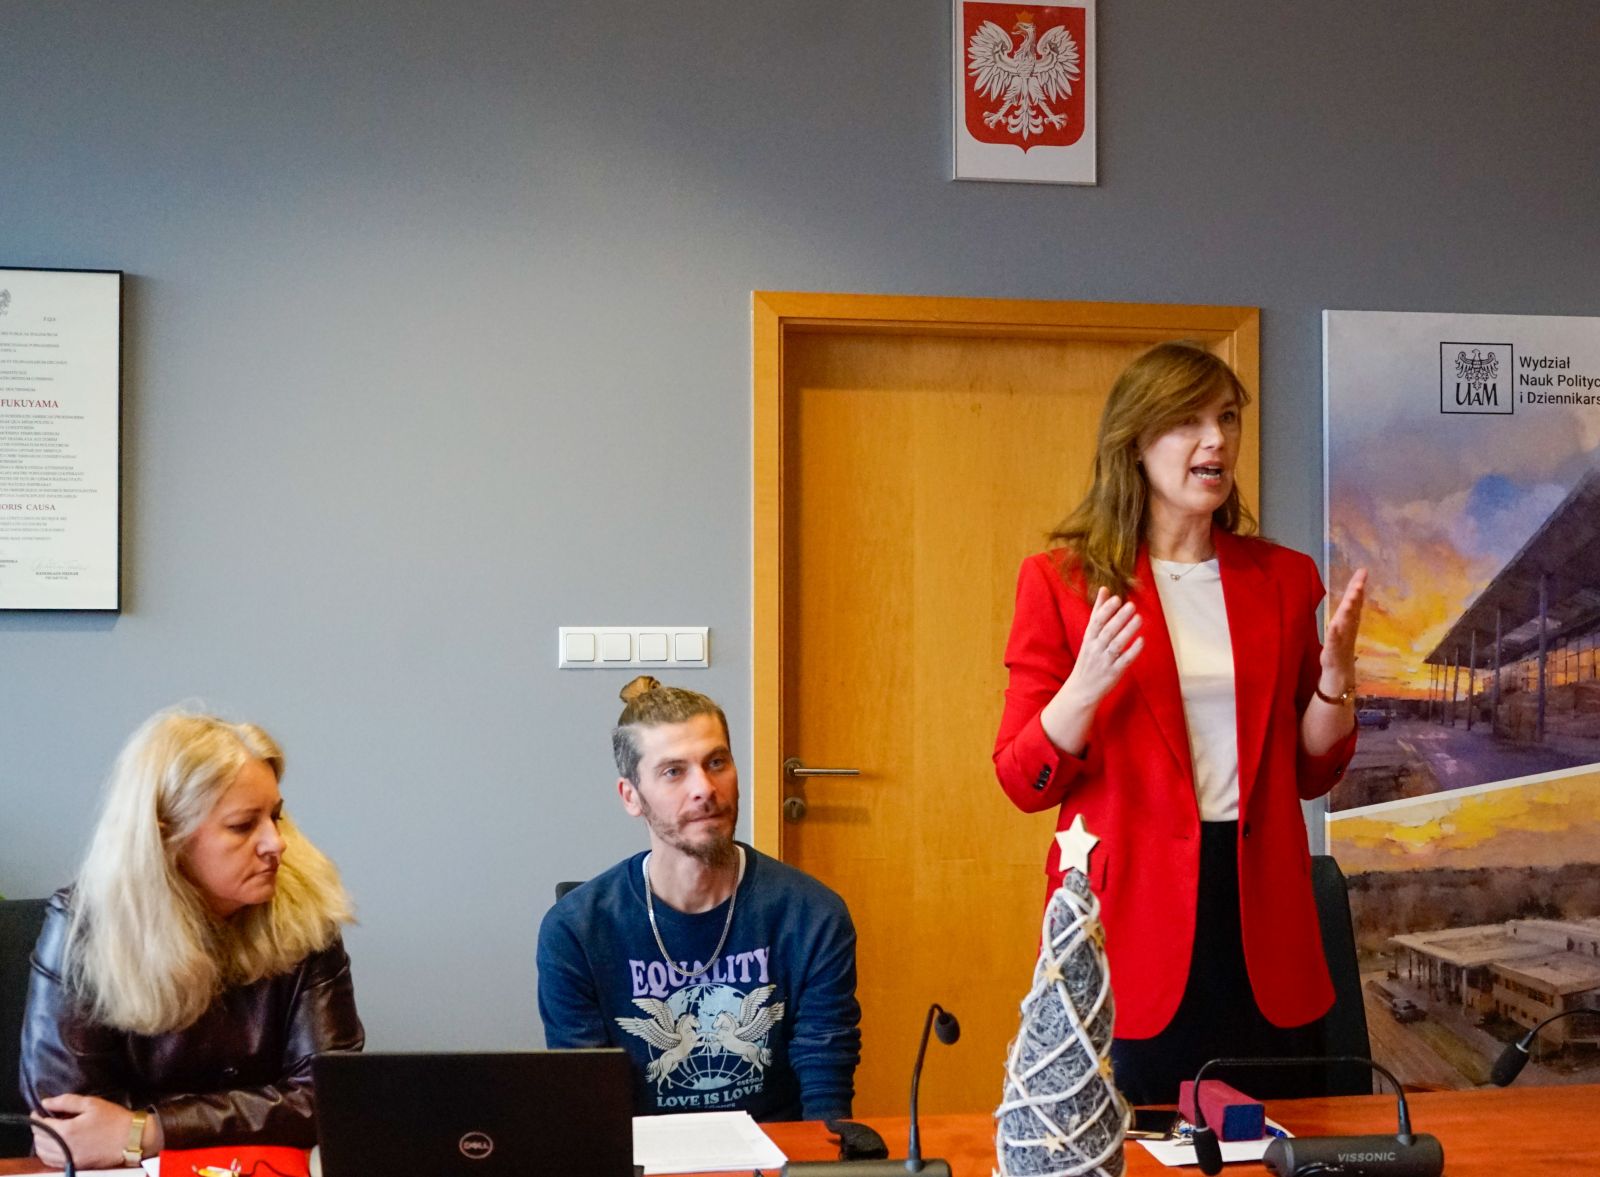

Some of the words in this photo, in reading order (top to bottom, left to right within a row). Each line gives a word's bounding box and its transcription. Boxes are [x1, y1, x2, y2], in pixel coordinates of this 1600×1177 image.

[1519, 355, 1570, 372] Wydział
[1519, 373, 1553, 386] Nauk
[1456, 382, 1498, 406] UAM
[1519, 391, 1523, 404] i
[1, 399, 59, 408] FUKUYAMA
[0, 503, 23, 511] ORIS
[26, 503, 56, 511] CAUSA
[629, 946, 770, 998] EQUALITY
[656, 1095, 700, 1107] LOVE
[703, 1092, 720, 1105] IS
[723, 1083, 764, 1102] LOVE
[1337, 1151, 1397, 1163] VISSONIC
